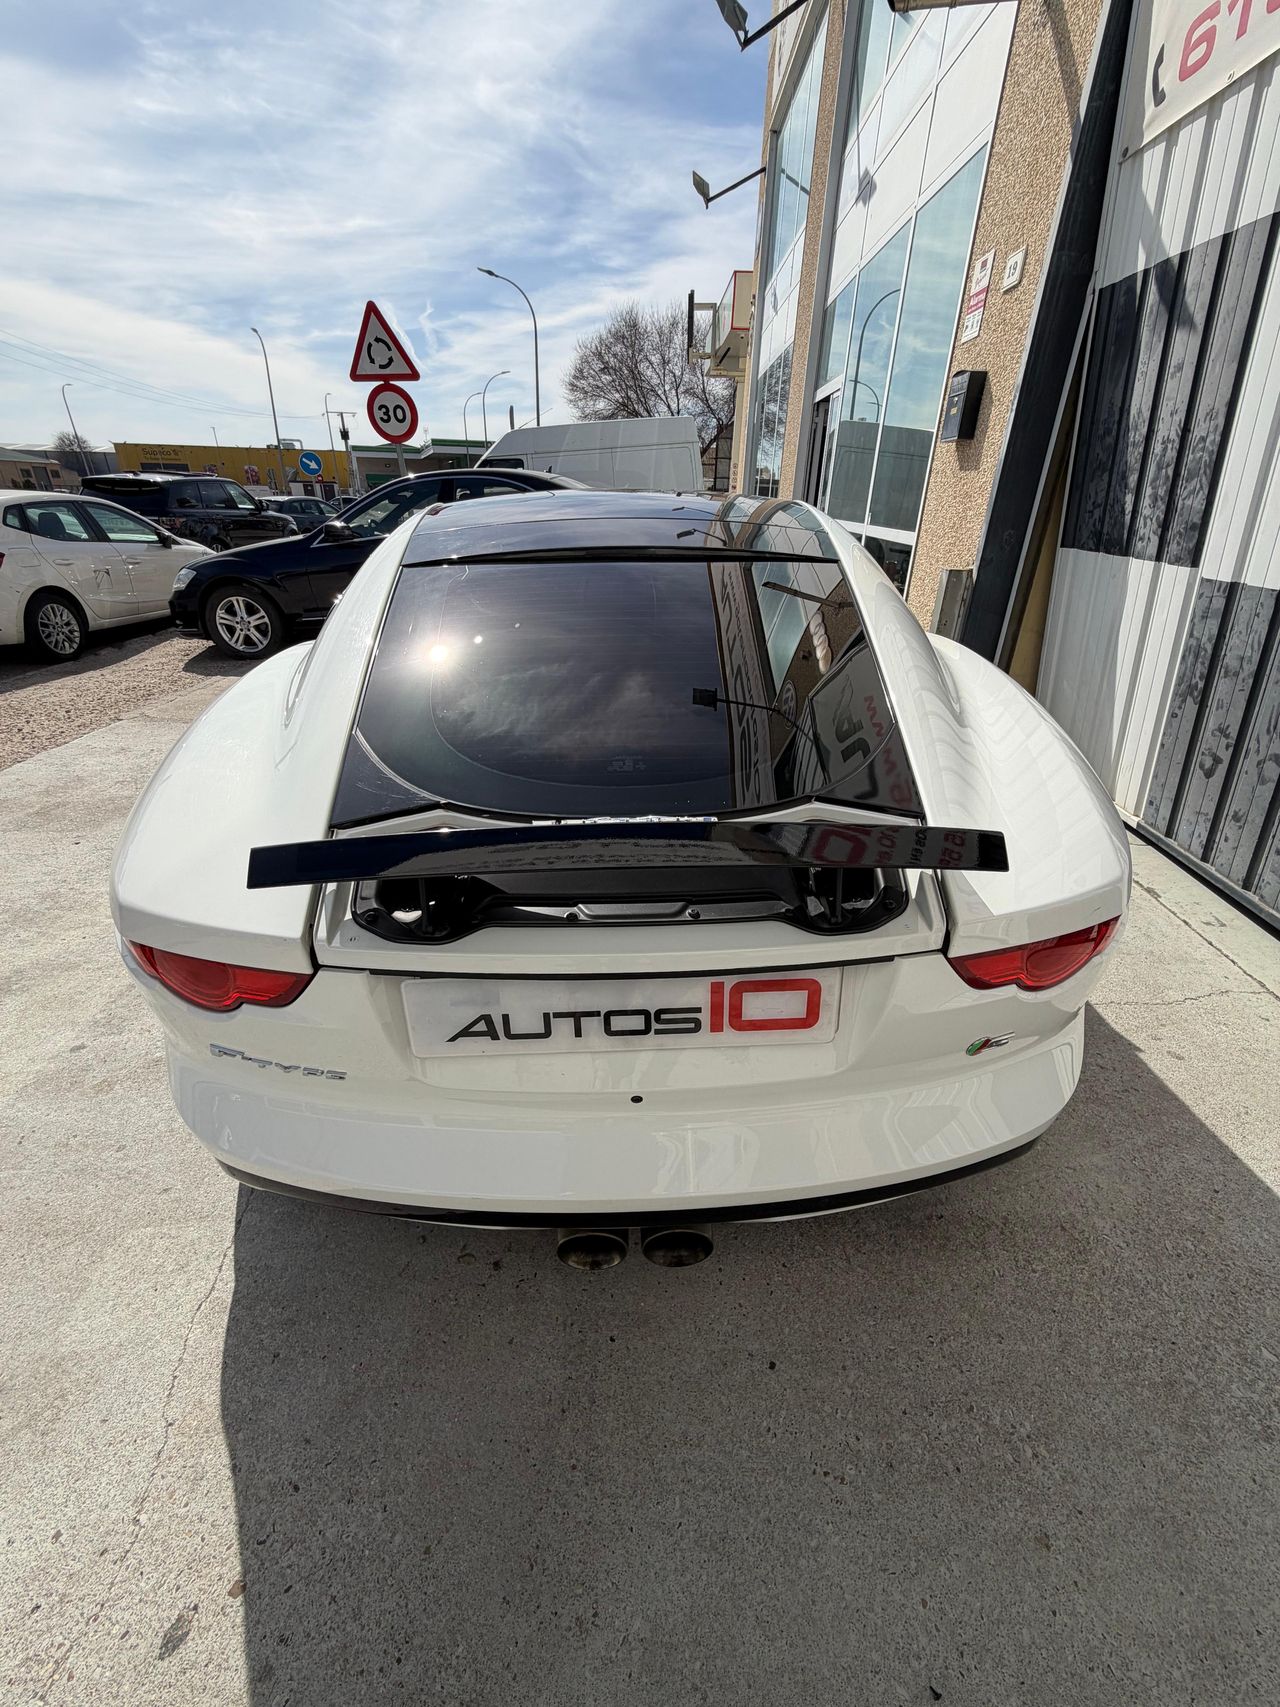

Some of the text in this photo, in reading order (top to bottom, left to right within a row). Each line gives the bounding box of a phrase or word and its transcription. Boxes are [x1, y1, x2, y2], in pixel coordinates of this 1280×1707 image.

[1178, 0, 1280, 82] 61
[1006, 260, 1018, 280] 19
[377, 403, 407, 424] 30
[209, 1042, 348, 1081] F-TYPE
